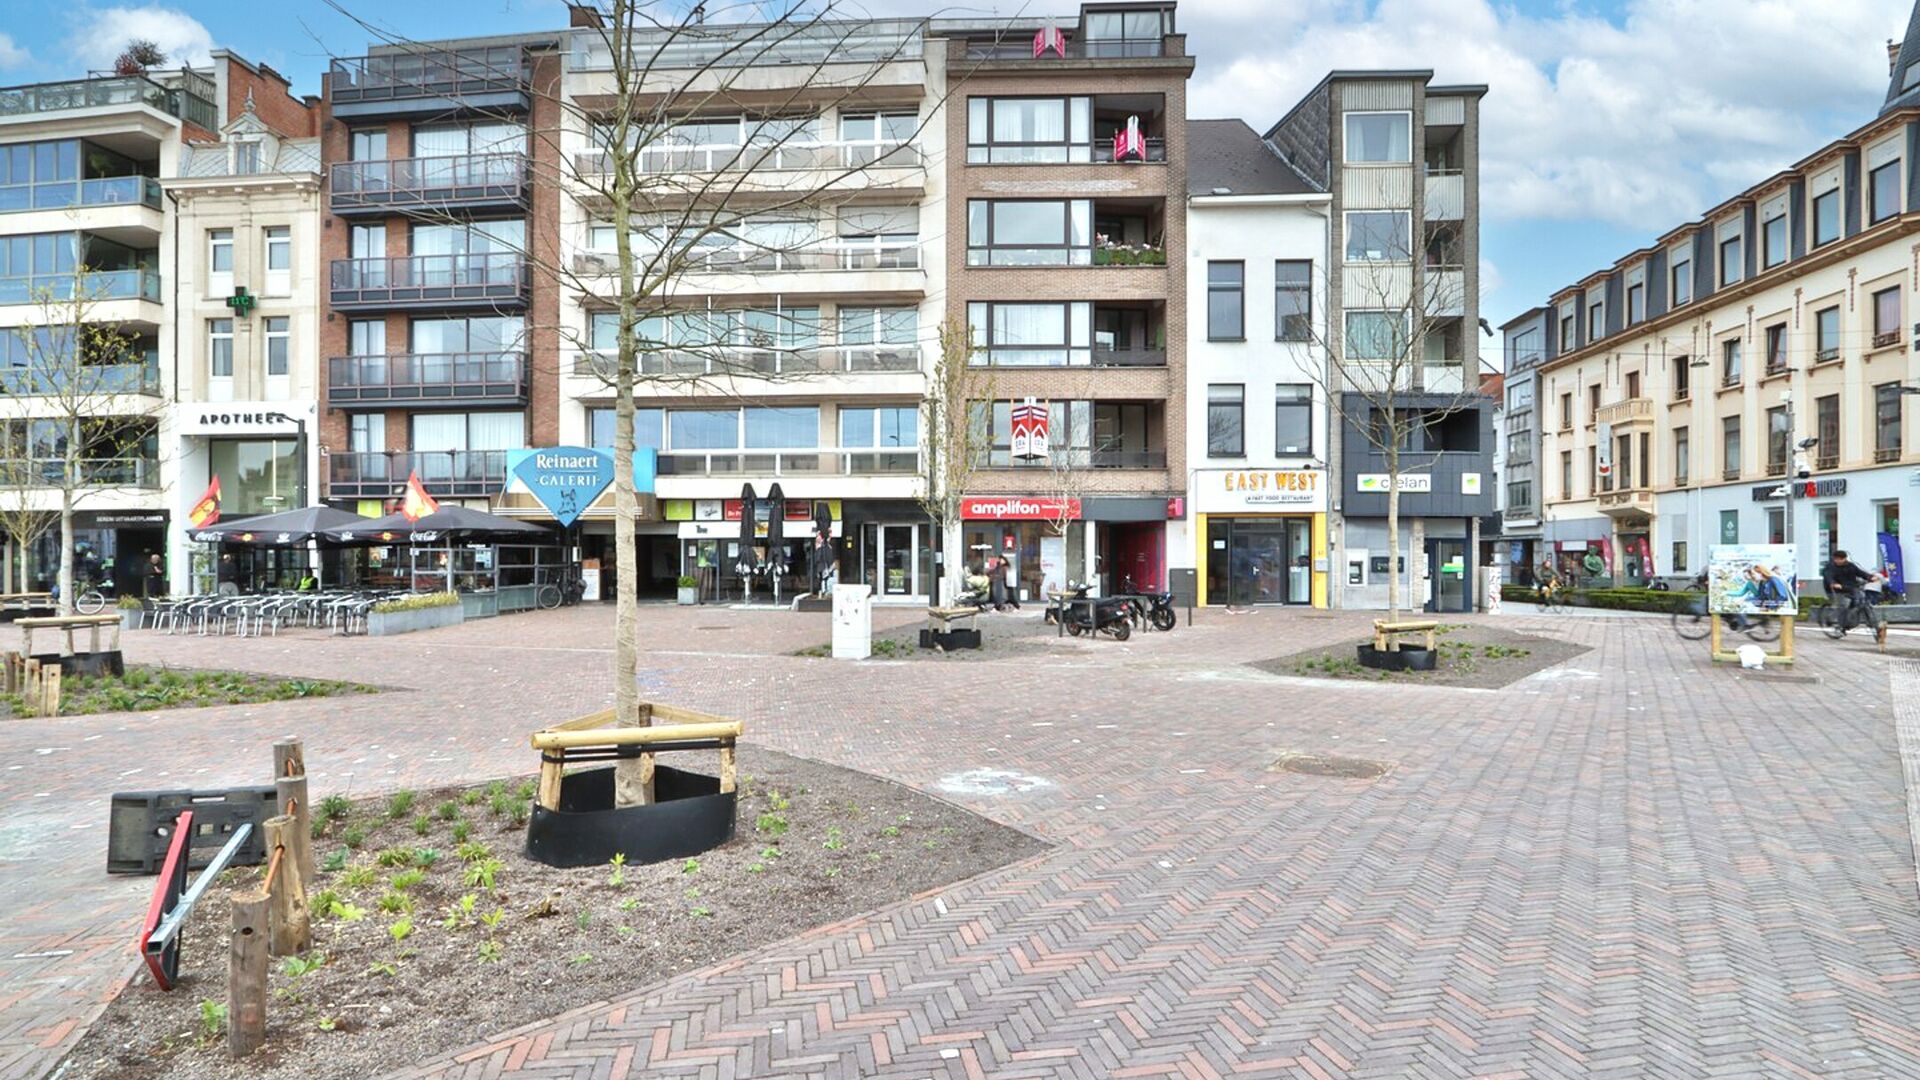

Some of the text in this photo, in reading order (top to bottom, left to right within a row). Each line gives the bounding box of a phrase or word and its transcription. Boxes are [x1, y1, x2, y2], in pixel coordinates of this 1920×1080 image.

[536, 454, 599, 469] Reinaert
[540, 475, 597, 487] GALERIJ
[1225, 472, 1318, 491] EAST WEST
[1380, 477, 1428, 489] celan
[971, 500, 1040, 518] amplifon
